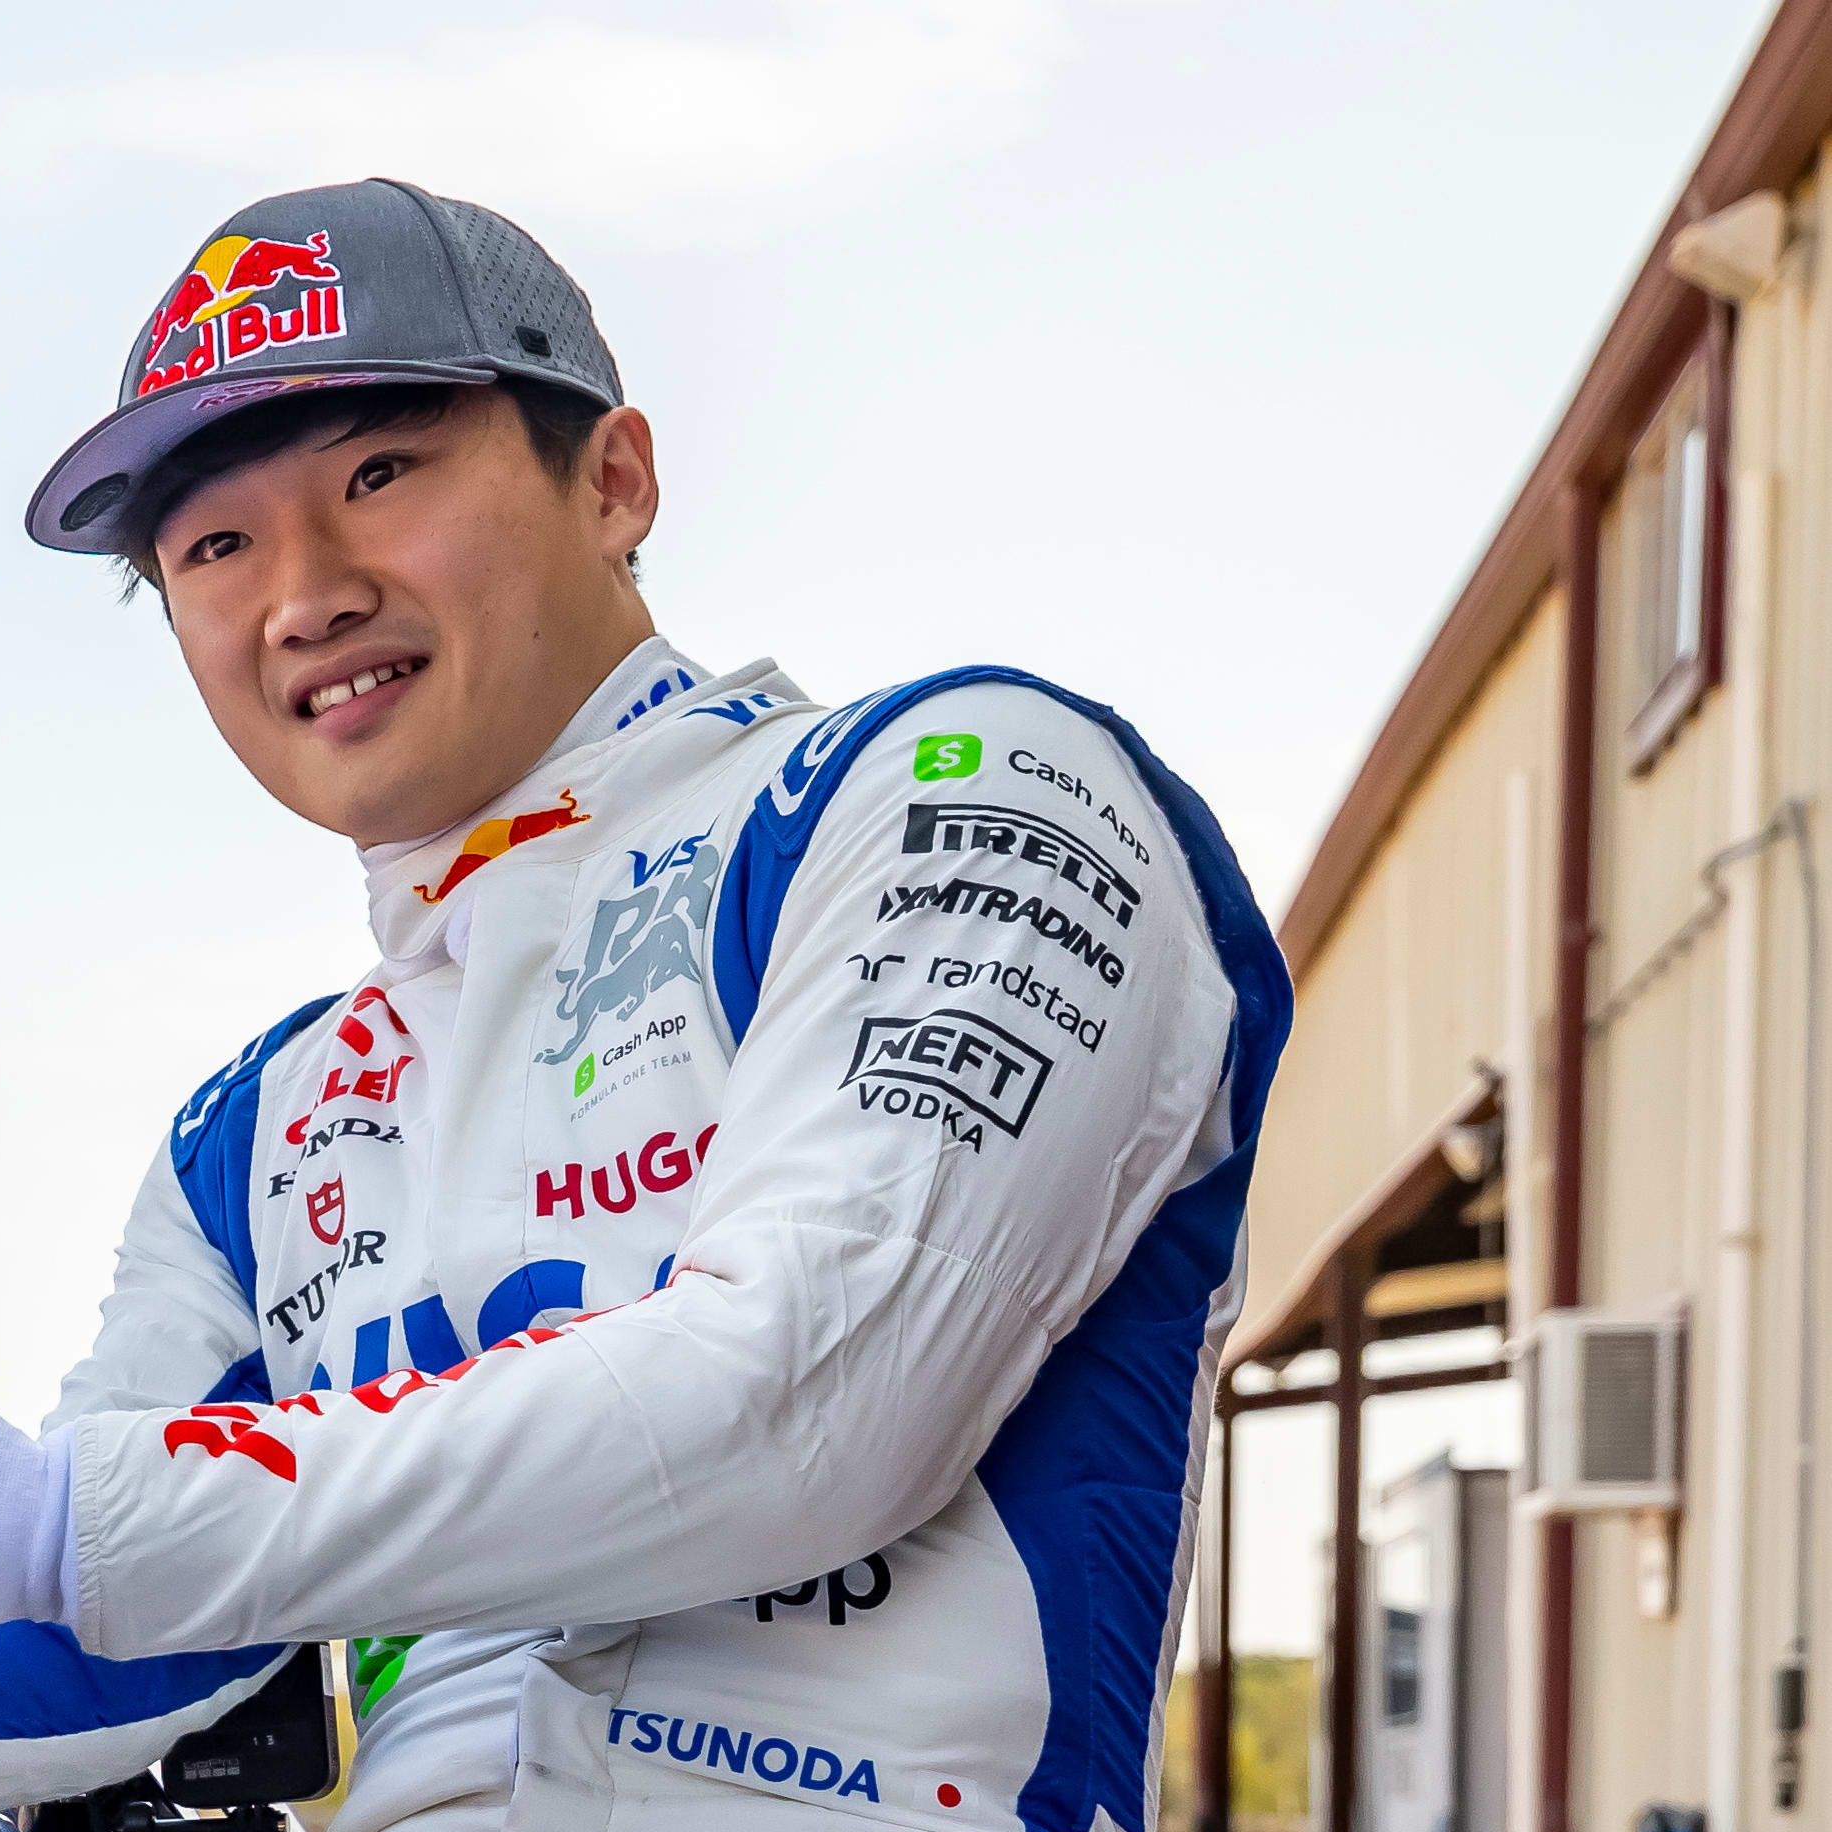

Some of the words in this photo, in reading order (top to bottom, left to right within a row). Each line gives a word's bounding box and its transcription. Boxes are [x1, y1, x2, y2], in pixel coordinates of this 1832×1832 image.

[227, 286, 341, 358] Bull
[1008, 749, 1093, 807] Cash
[1099, 803, 1151, 866] App
[901, 802, 1141, 930] PIRELLI
[602, 1033, 642, 1067] Cash
[645, 1013, 687, 1042] App
[926, 956, 1108, 1054] randstad
[570, 1082, 618, 1123] FORMULA
[622, 1064, 647, 1086] ONE
[650, 1051, 693, 1070] TEAM
[865, 1024, 1026, 1101] NEFT
[858, 1082, 984, 1154] VODKA
[608, 1708, 880, 1803] TSUNODA
